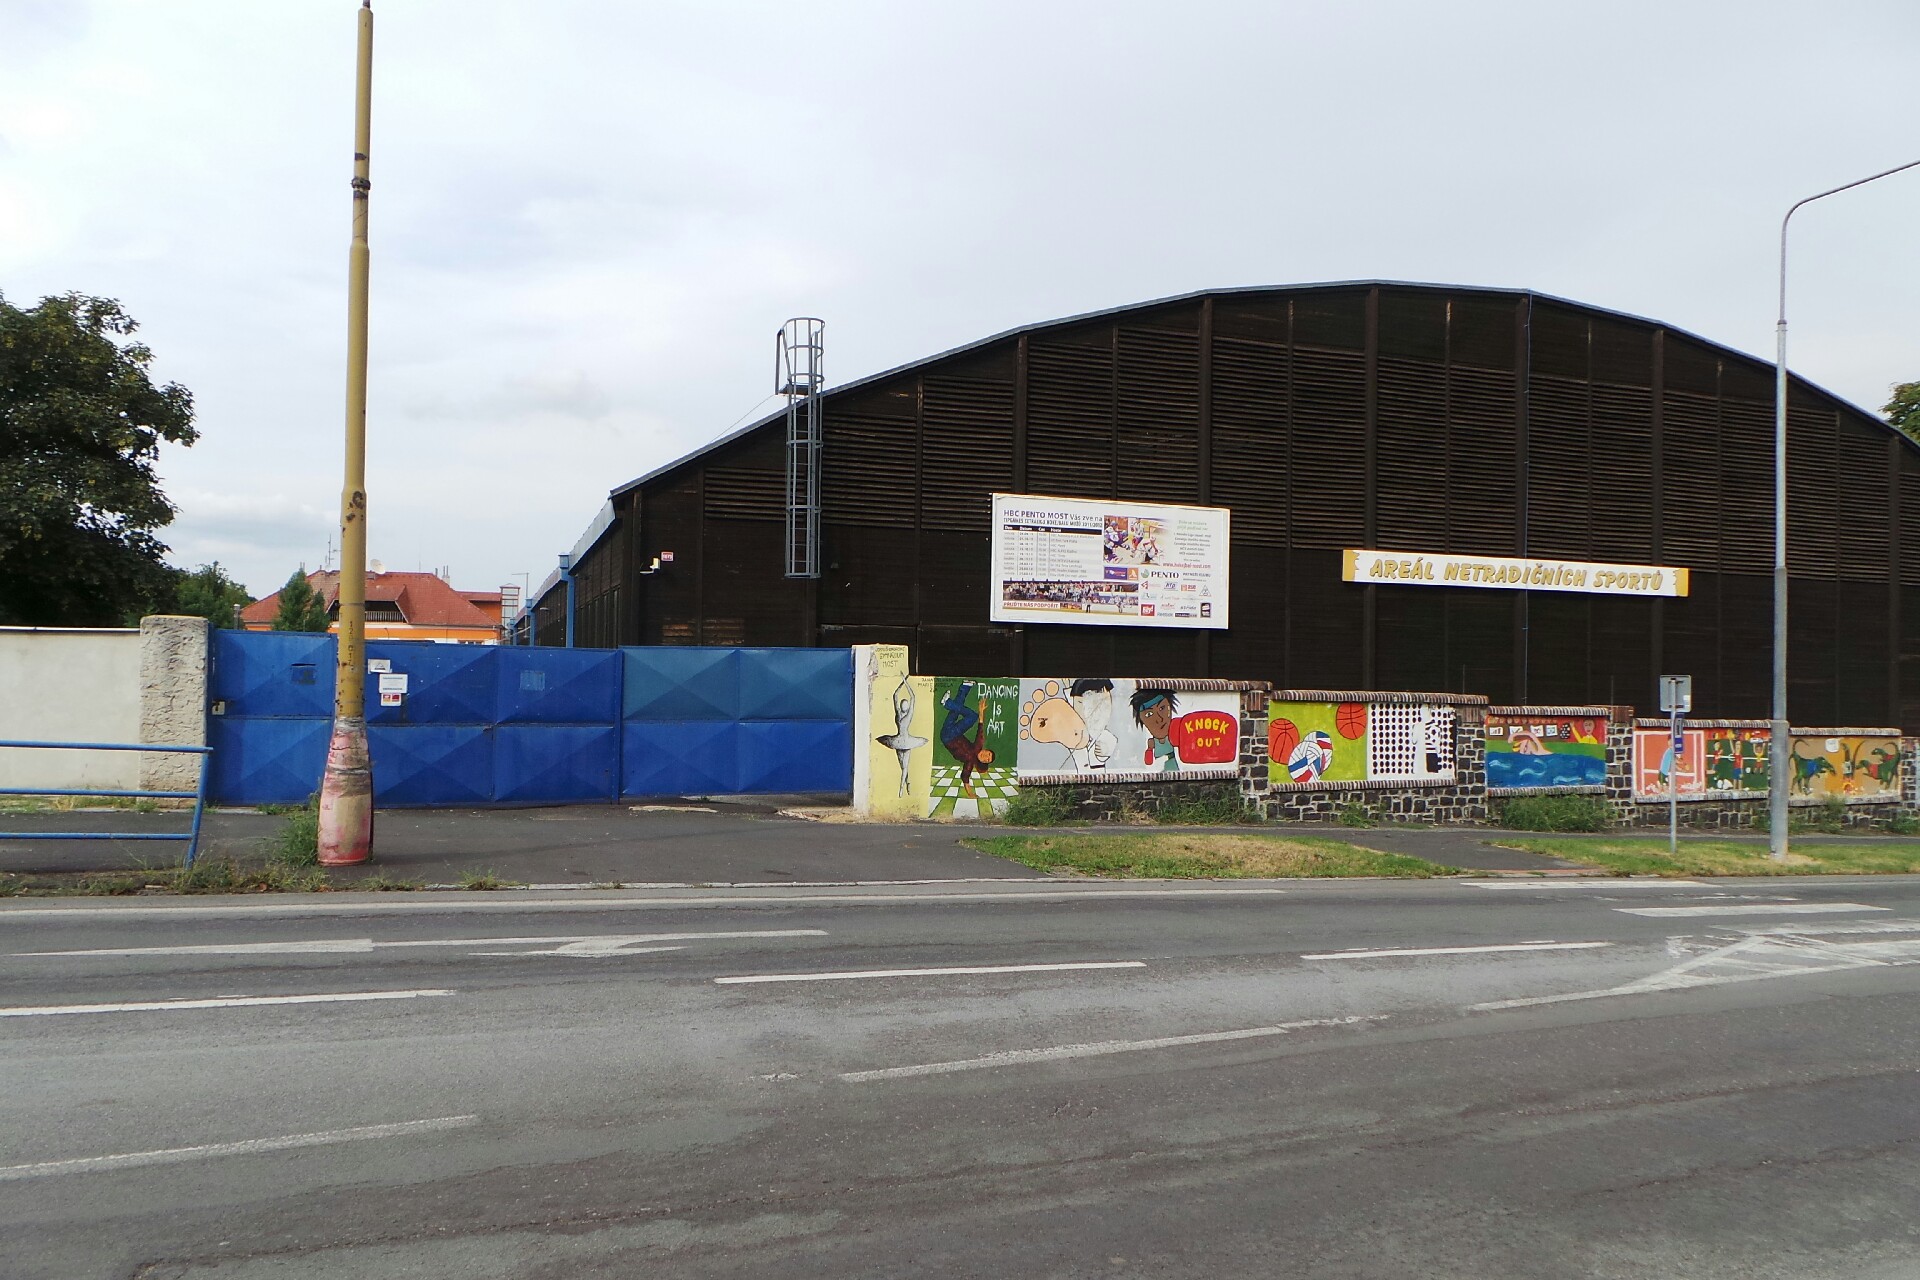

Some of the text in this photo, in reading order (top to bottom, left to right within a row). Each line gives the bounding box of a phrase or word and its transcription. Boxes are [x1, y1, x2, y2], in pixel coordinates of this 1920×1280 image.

[1003, 509, 1019, 517] HBC
[1047, 512, 1068, 520] MOST
[1150, 571, 1179, 579] PENTO
[1369, 557, 1664, 591] AREÁL NETRADIČNÍCH SPORTŮ
[882, 660, 899, 668] MOST
[977, 682, 1018, 700] DANCING
[1184, 718, 1230, 734] KNOCK
[1196, 737, 1221, 747] OUT
